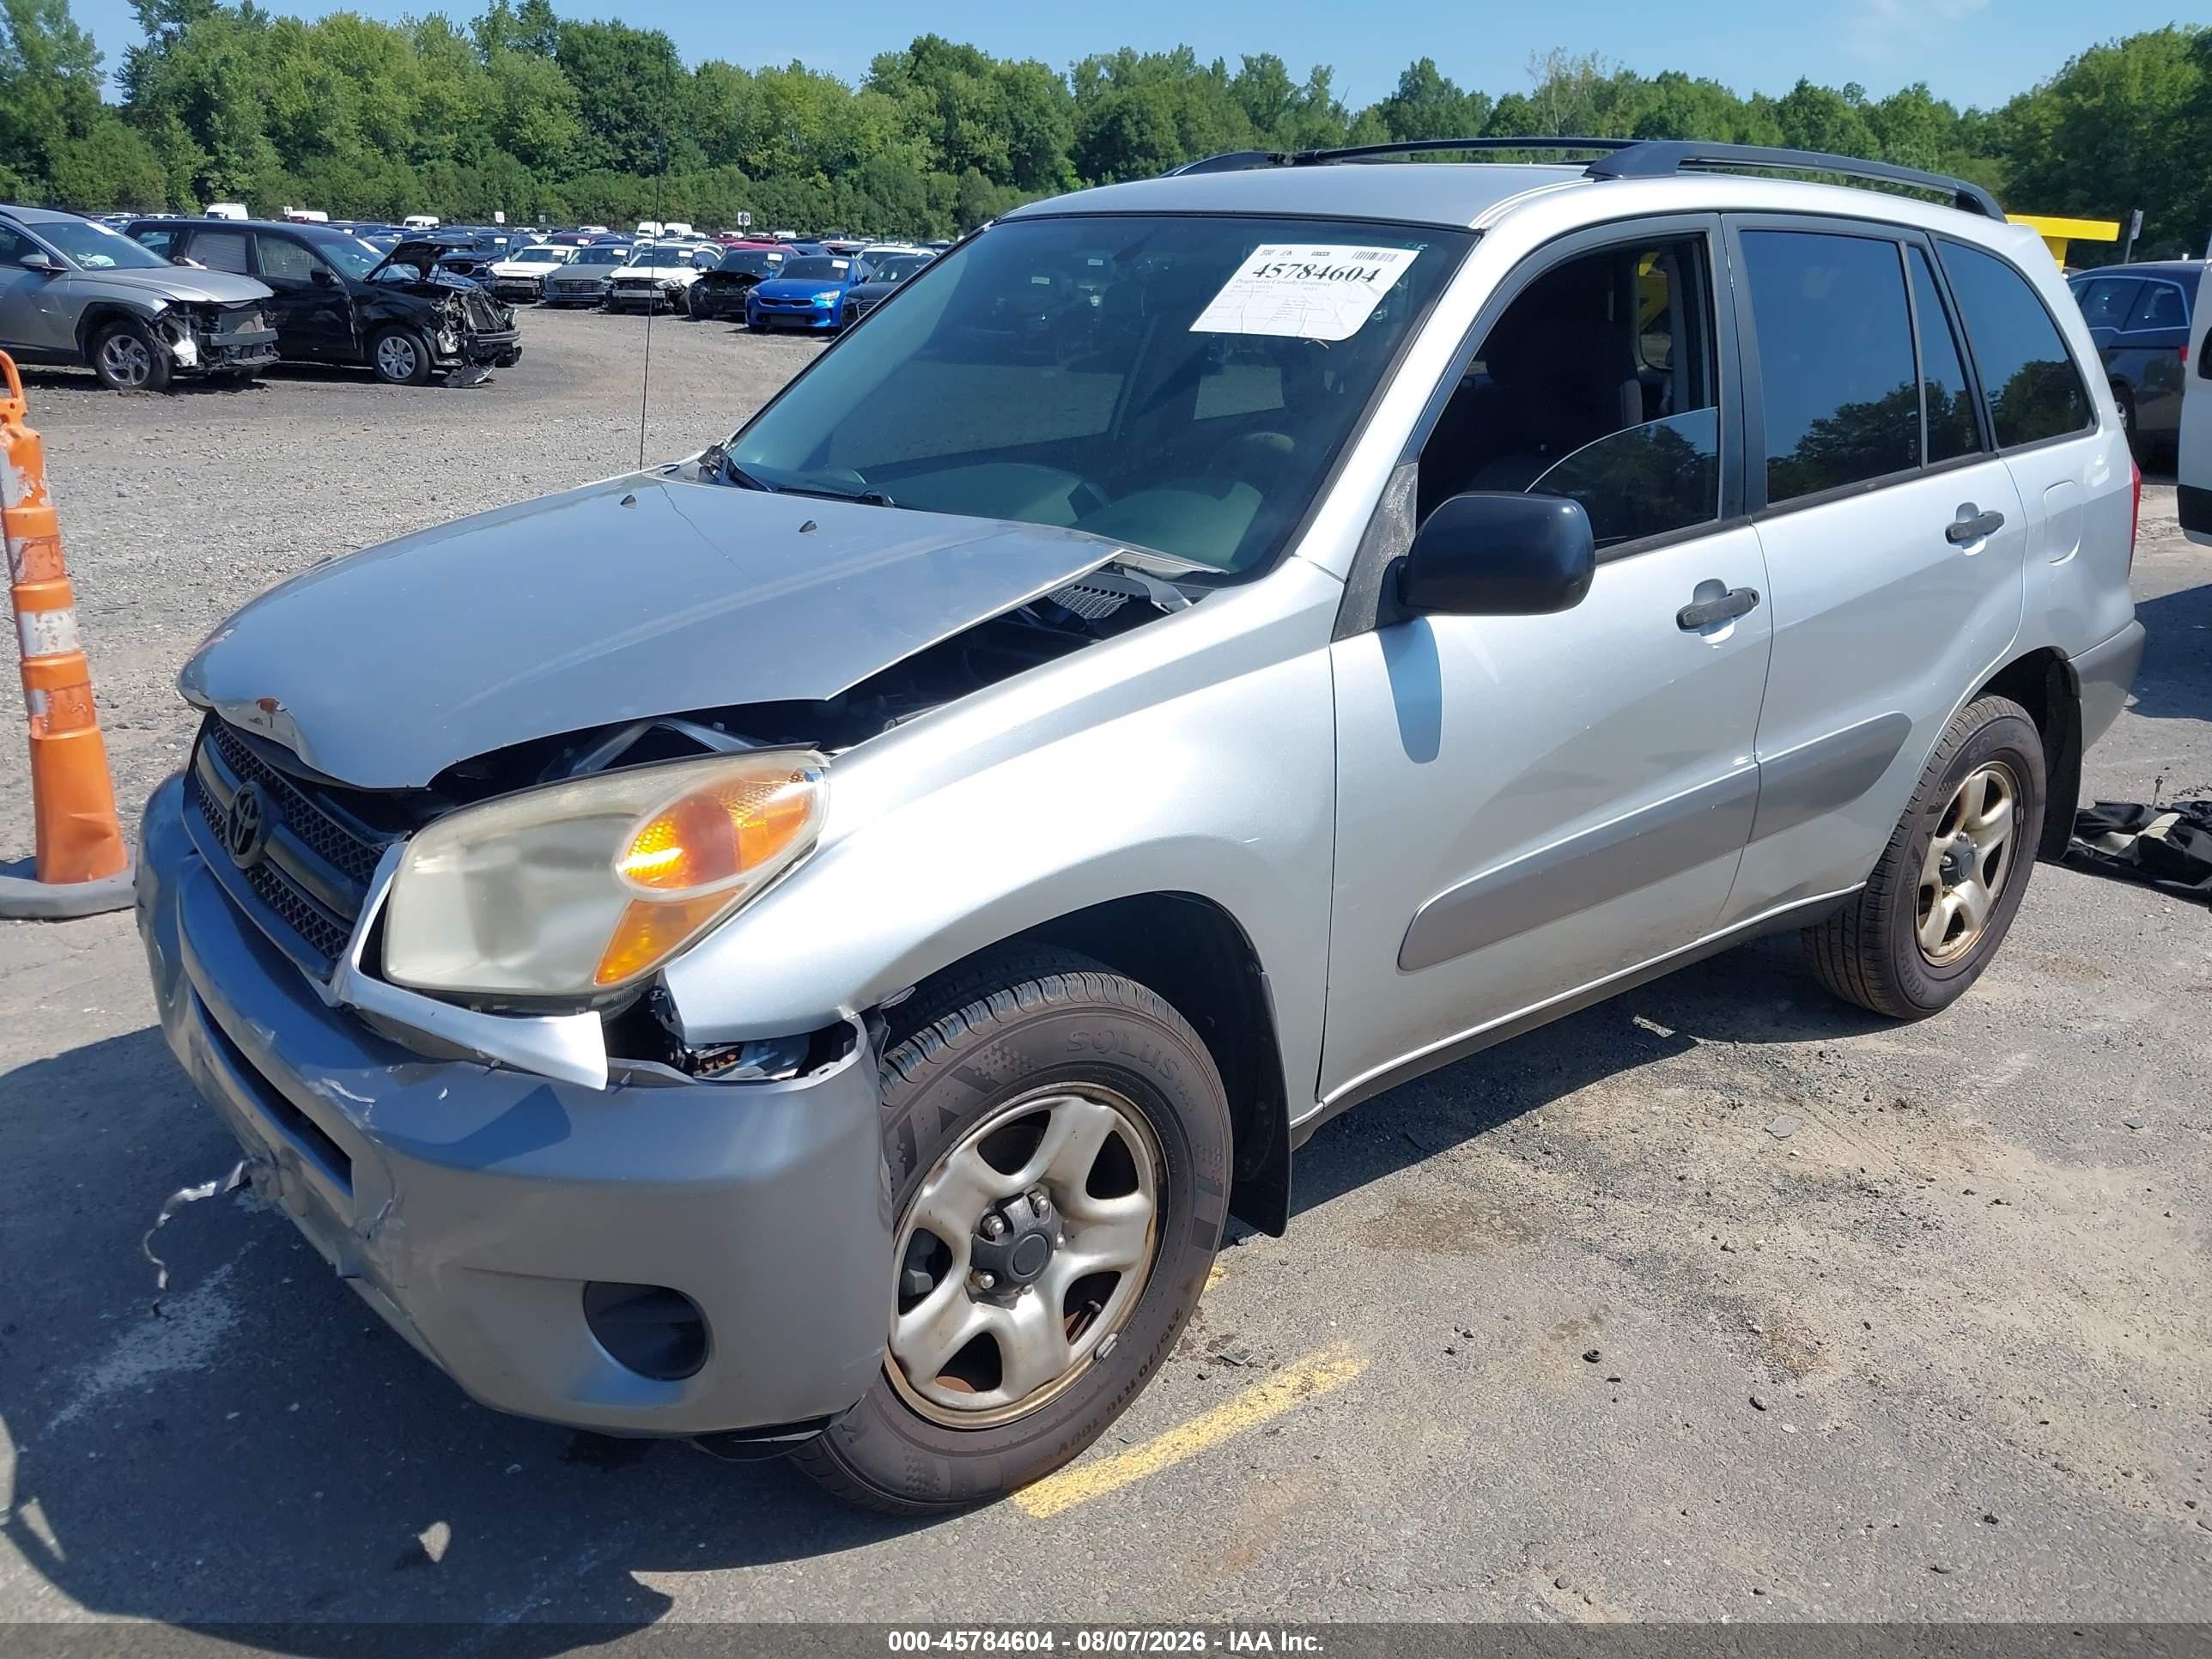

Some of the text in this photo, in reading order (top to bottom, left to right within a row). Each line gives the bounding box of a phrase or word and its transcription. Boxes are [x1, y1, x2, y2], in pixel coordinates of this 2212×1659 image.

[1252, 263, 1382, 283] 45784604
[1900, 938, 1929, 1000] KUMHO
[1065, 1029, 1182, 1080] SOLUS
